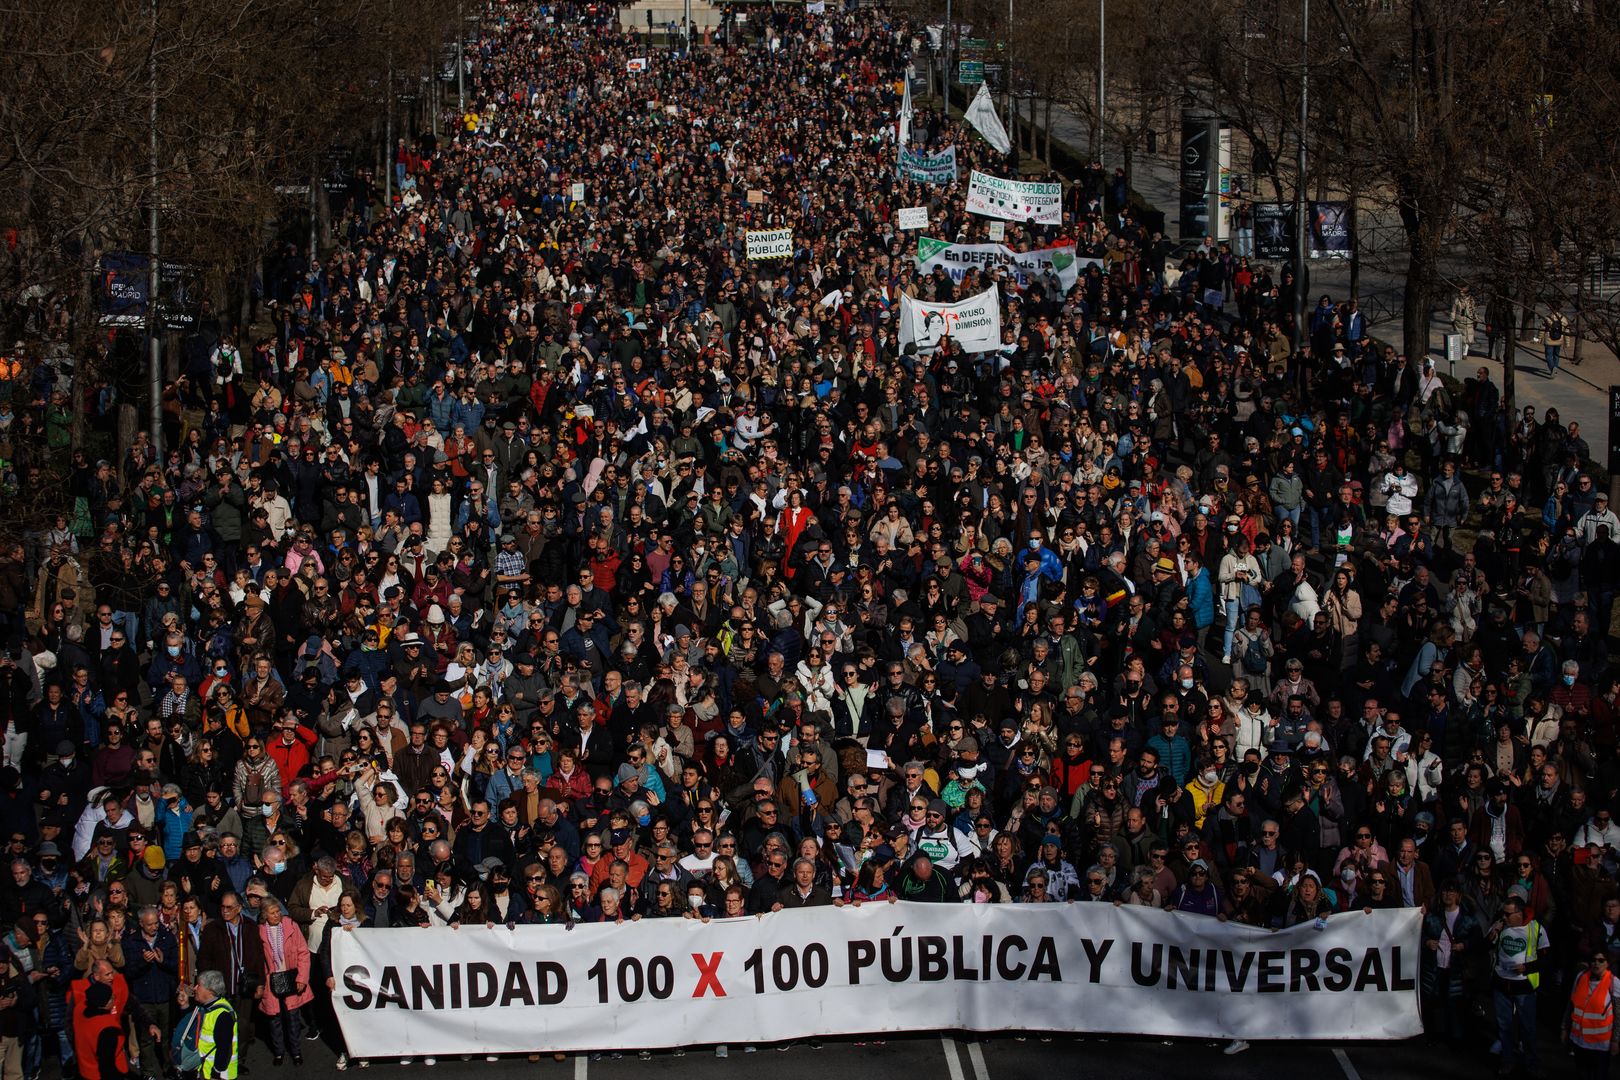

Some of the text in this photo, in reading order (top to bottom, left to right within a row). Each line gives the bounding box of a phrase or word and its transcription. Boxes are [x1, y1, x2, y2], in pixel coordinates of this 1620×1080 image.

[747, 231, 792, 243] SANIDAD
[748, 244, 792, 255] PÚBLICA
[945, 250, 959, 262] En
[962, 250, 1016, 265] DEFENSA
[1017, 259, 1035, 269] de
[179, 314, 194, 322] feb
[958, 307, 985, 319] AYUSO
[955, 317, 992, 330] DIMISIÓN
[343, 926, 1416, 1010] SANIDAD 100 X 100 PÚBLICA Y UNIVERSAL
